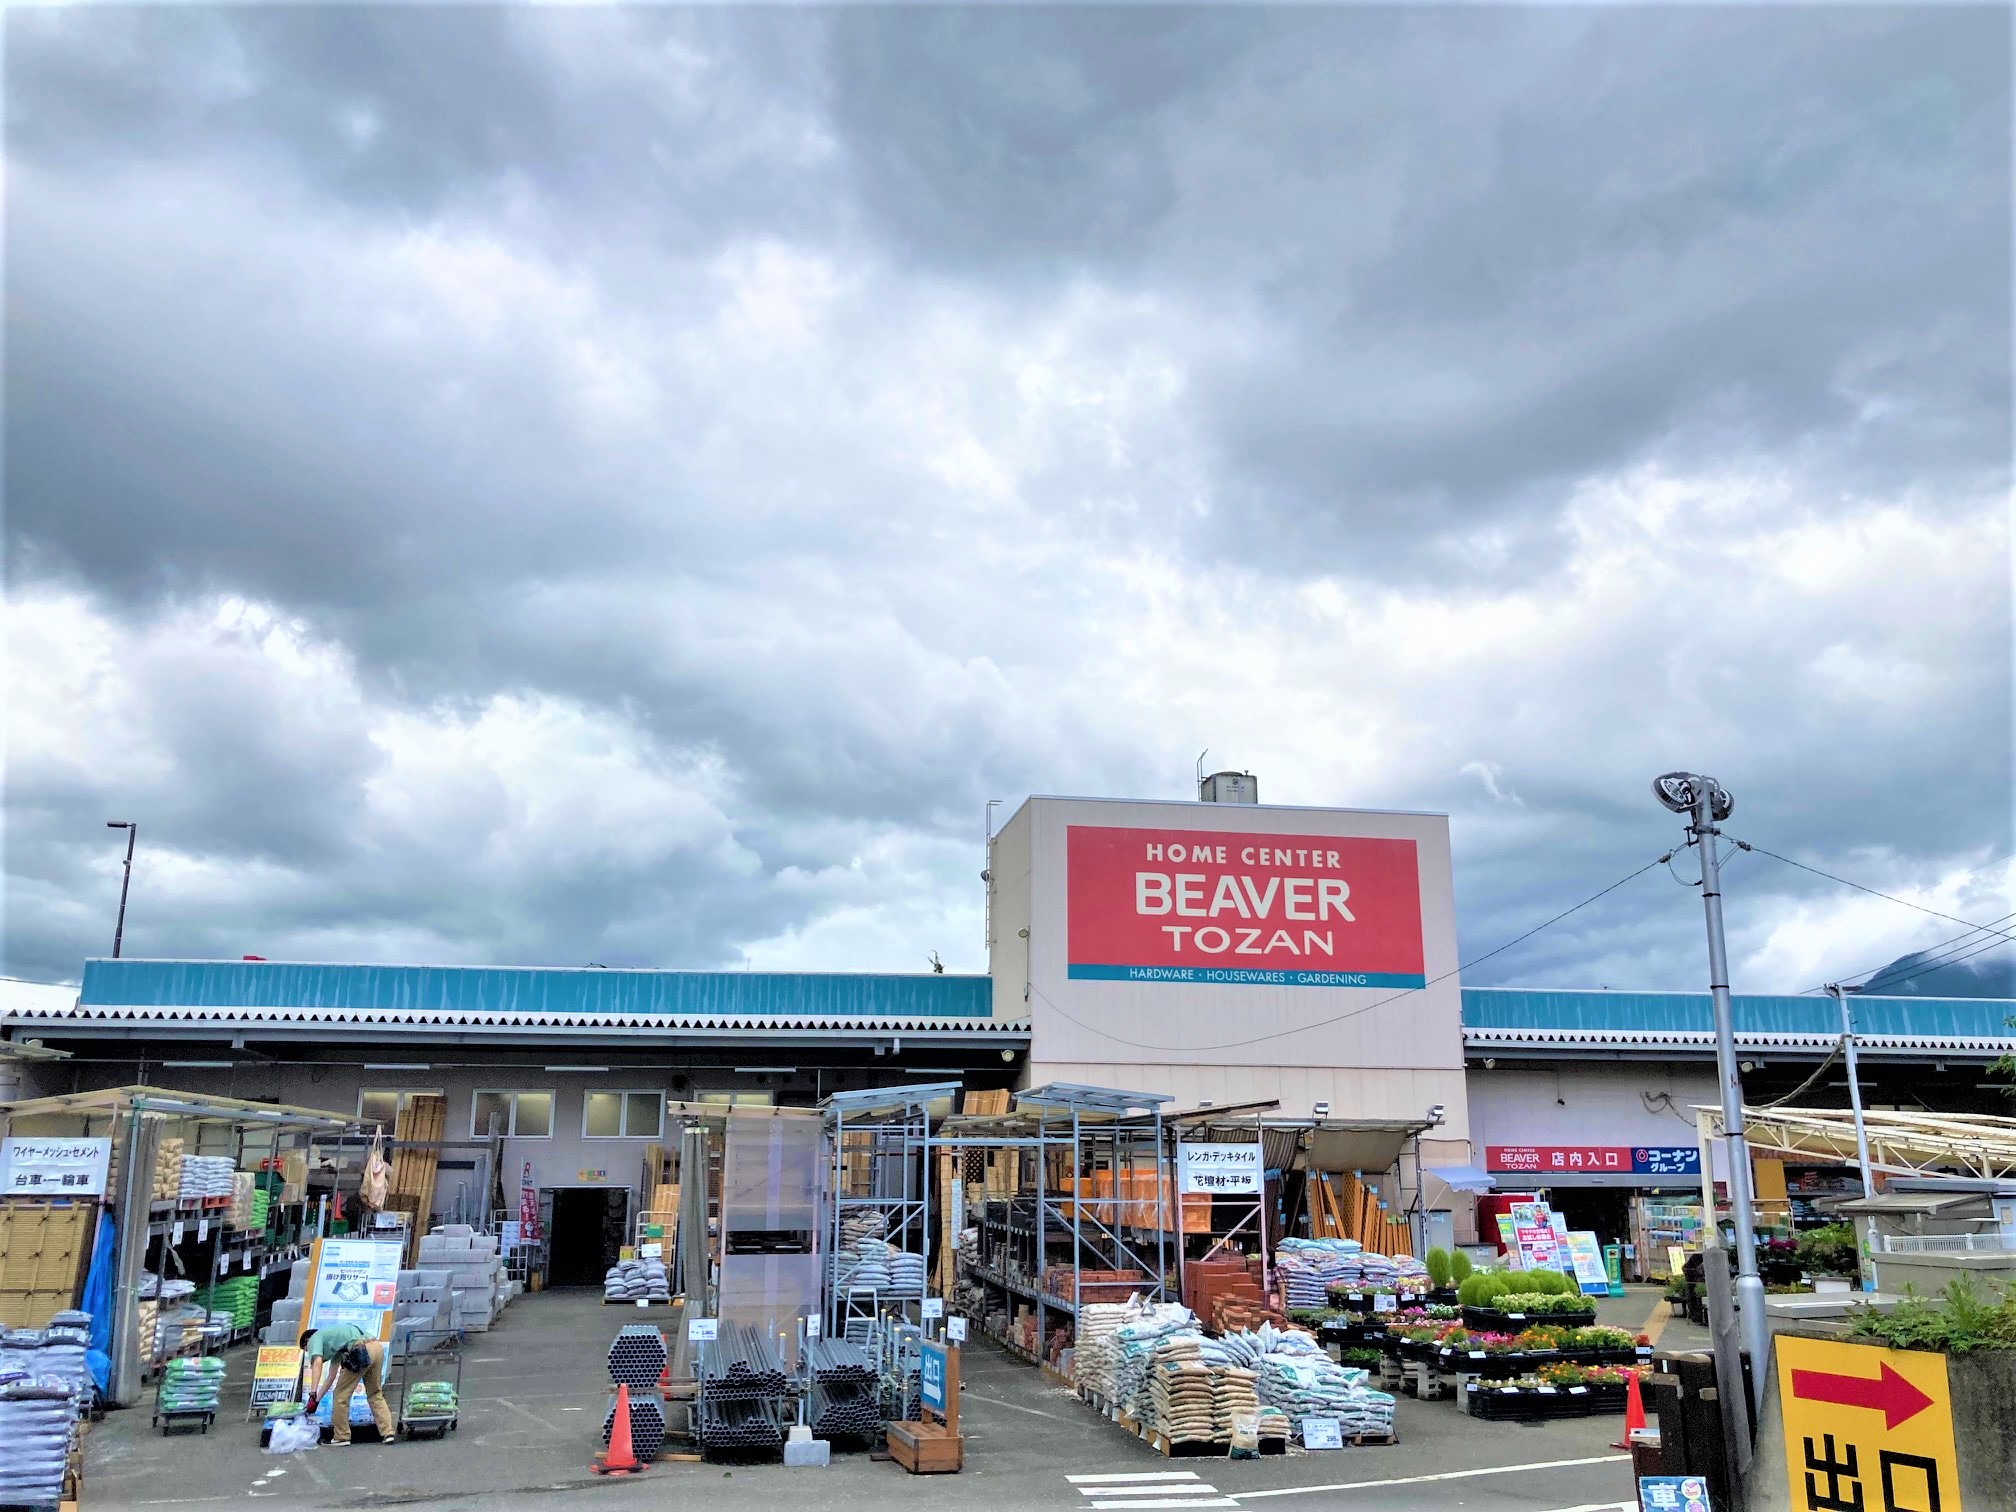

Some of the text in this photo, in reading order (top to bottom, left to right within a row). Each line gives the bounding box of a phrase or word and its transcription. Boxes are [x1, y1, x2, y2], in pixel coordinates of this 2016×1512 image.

[1146, 843, 1342, 869] HOME CENTER
[1135, 871, 1355, 922] BEAVER
[1161, 925, 1334, 956] TOZAN
[1129, 968, 1367, 985] HARDWARE HOUSEWARES GARDENING
[13, 1147, 99, 1158] ワイヤーメッシュ・セメント
[1187, 1151, 1256, 1162] レンガ・デッキタイル
[1500, 1154, 1540, 1163] BEAVER
[1551, 1152, 1618, 1167] 店内入口
[1648, 1150, 1697, 1162] コーナン
[1650, 1162, 1685, 1172] グループ
[15, 1174, 90, 1186] 台車・一輪車
[1193, 1175, 1252, 1187] 花壇材・平板
[924, 1354, 940, 1381] 出口
[1803, 1434, 1941, 1512] 出口
[1648, 1482, 1680, 1511] 車
